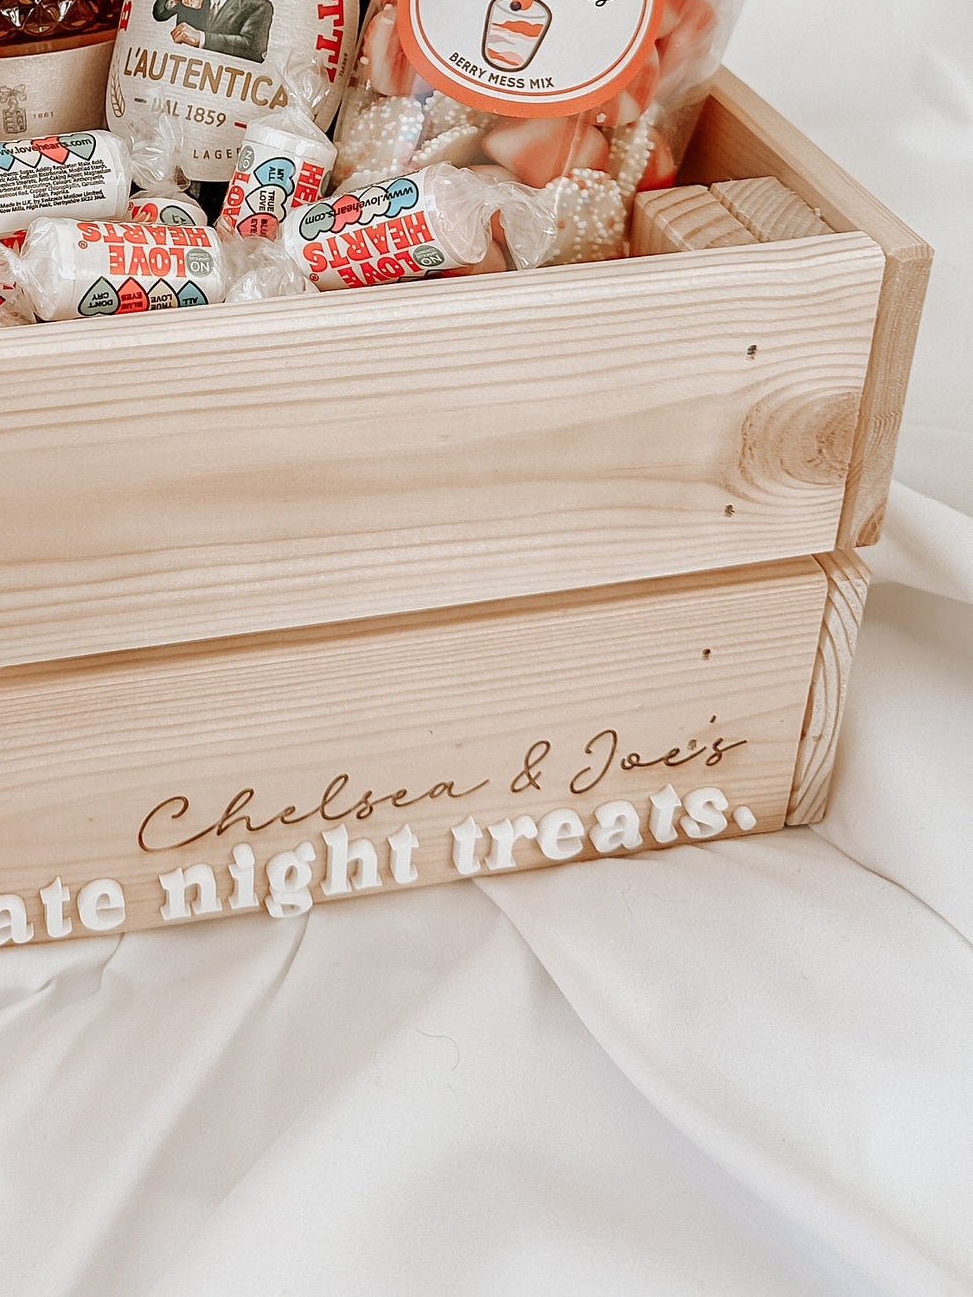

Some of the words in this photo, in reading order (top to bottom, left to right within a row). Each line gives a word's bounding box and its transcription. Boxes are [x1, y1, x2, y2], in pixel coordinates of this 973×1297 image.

[123, 46, 289, 111] L'AUTENTICA
[448, 52, 487, 80] BERRY
[488, 73, 525, 89] MESS
[529, 77, 555, 90] MIX
[184, 104, 227, 128] 1859
[241, 150, 253, 169] NO
[268, 166, 276, 182] ALL
[276, 168, 285, 181] MY
[223, 171, 251, 229] LOV
[258, 190, 267, 212] LOVE
[267, 190, 276, 213] TRUE
[304, 185, 414, 226] www.lovehearts.com
[76, 222, 212, 248] HEARTS
[250, 218, 258, 234] EYE
[259, 219, 269, 238] BLU
[302, 210, 435, 273] HEARTS
[109, 245, 187, 278] LOVE
[190, 262, 209, 273] NO
[337, 249, 424, 288] LOVE
[422, 254, 442, 267] NO
[87, 299, 114, 308] DON'T
[91, 292, 109, 301] CRY
[121, 292, 142, 301] EYES
[121, 301, 143, 310] BLUE
[148, 302, 173, 310] TRUE
[150, 294, 173, 303] LOVE
[182, 296, 199, 304] ALL
[138, 772, 492, 853] Chelsea
[509, 738, 552, 795] &
[569, 714, 749, 796] Joe's
[159, 823, 422, 919] night
[449, 783, 758, 877] treats.
